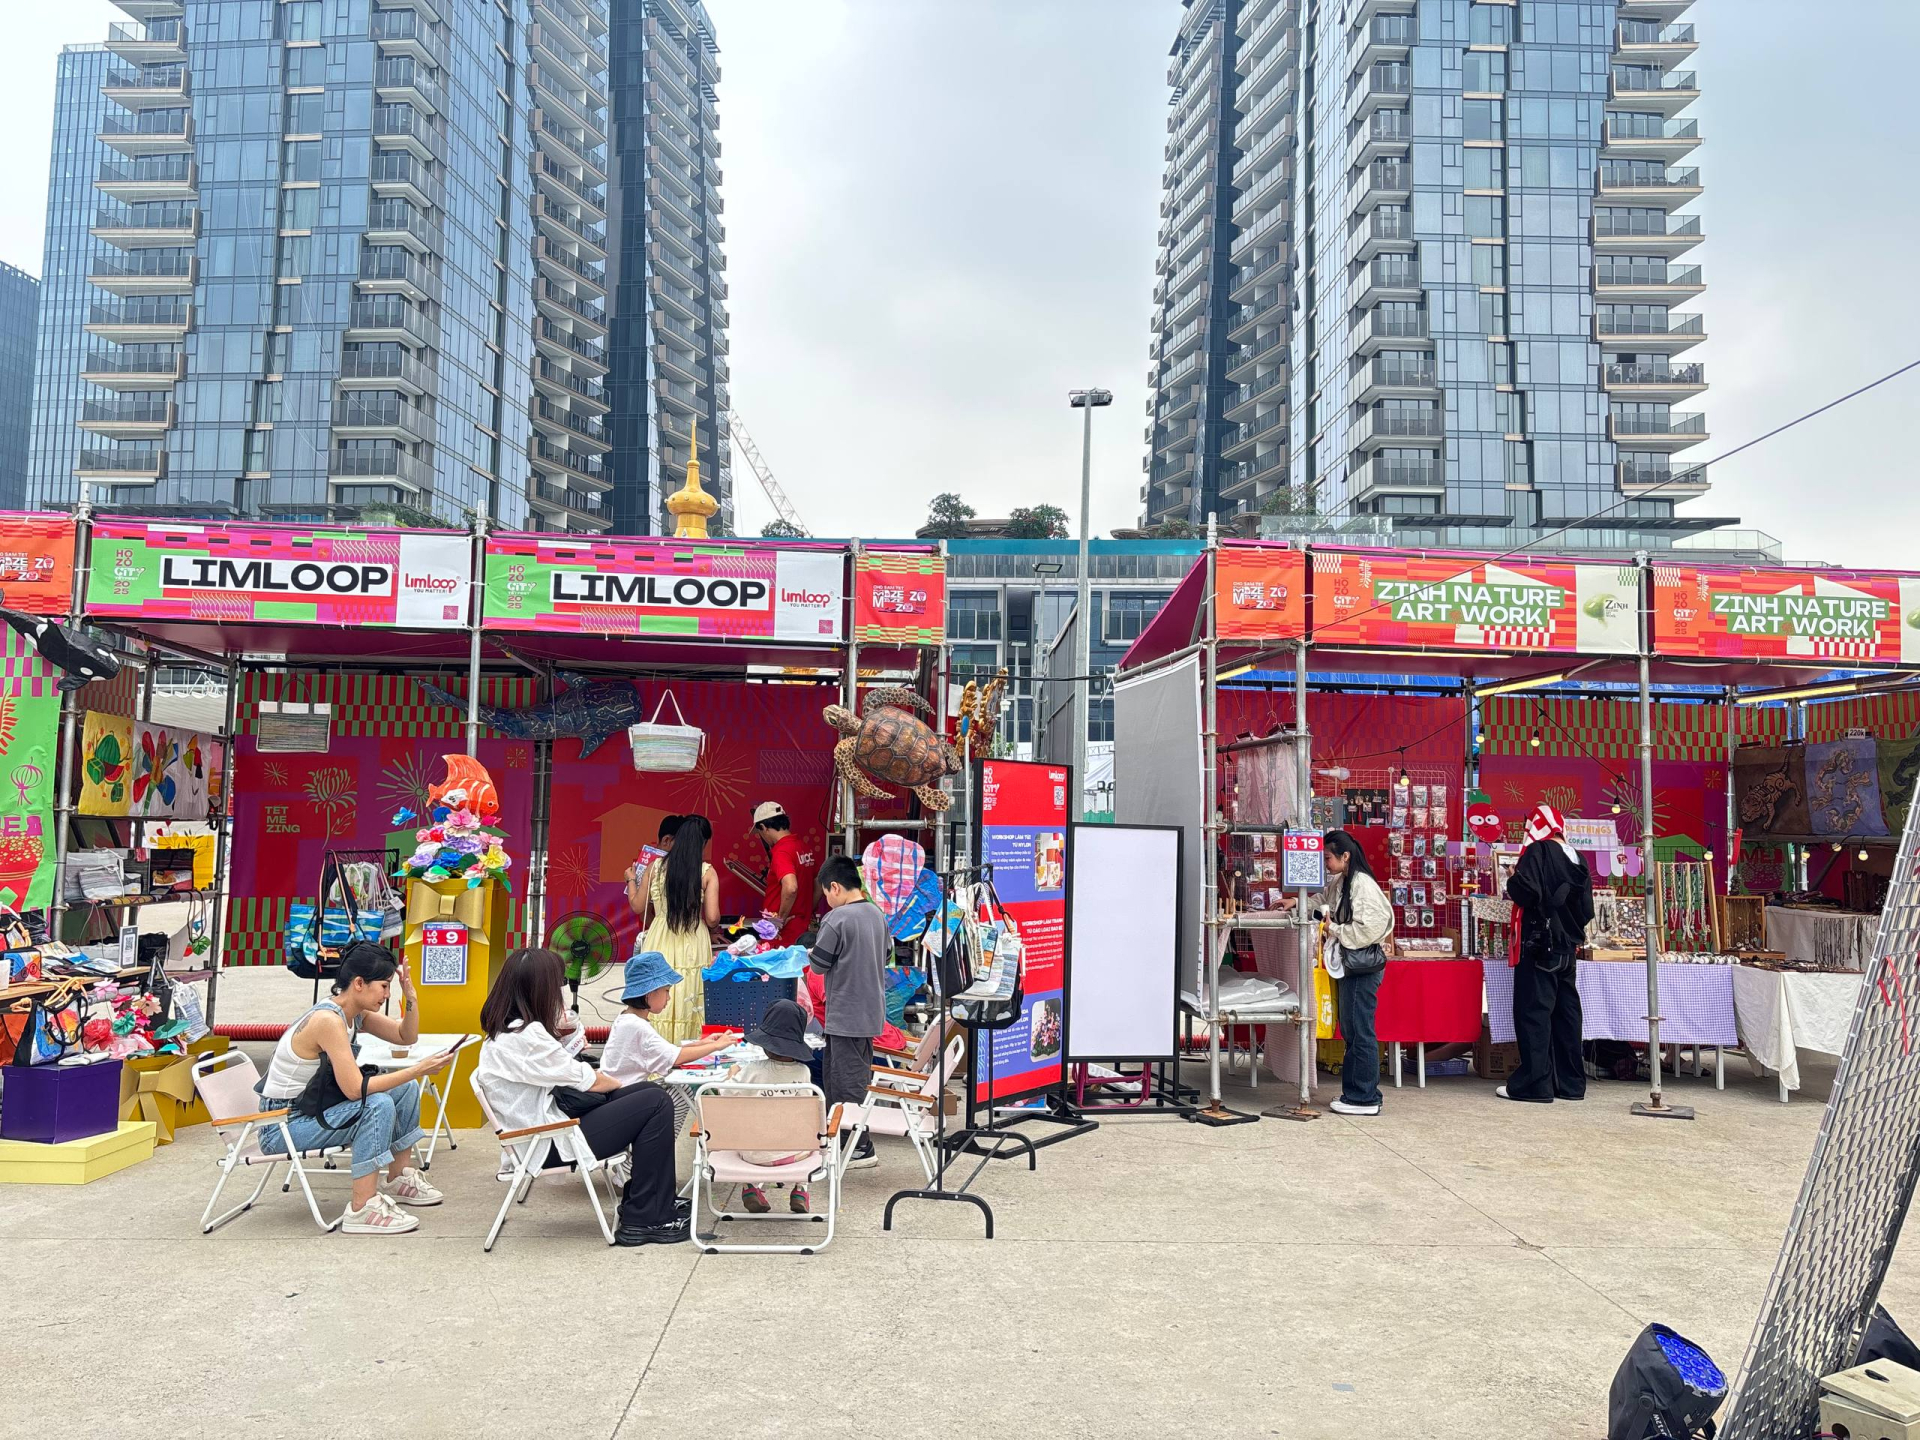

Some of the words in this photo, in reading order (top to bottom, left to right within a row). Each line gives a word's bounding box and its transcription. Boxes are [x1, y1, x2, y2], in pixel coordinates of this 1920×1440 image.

[163, 558, 389, 593] LIMLOOP
[553, 573, 766, 607] LIMLOOP
[1377, 581, 1447, 602] ZINH
[1453, 585, 1561, 607] NATURE
[1396, 602, 1453, 621] ART
[1460, 605, 1544, 625] WORK
[1714, 595, 1781, 615] ZINH
[1785, 598, 1886, 618] NATURE
[1731, 614, 1784, 633] ART
[1792, 617, 1869, 637] WORK
[266, 824, 300, 833] ZING
[1301, 838, 1319, 850] 19
[446, 931, 459, 944] 9
